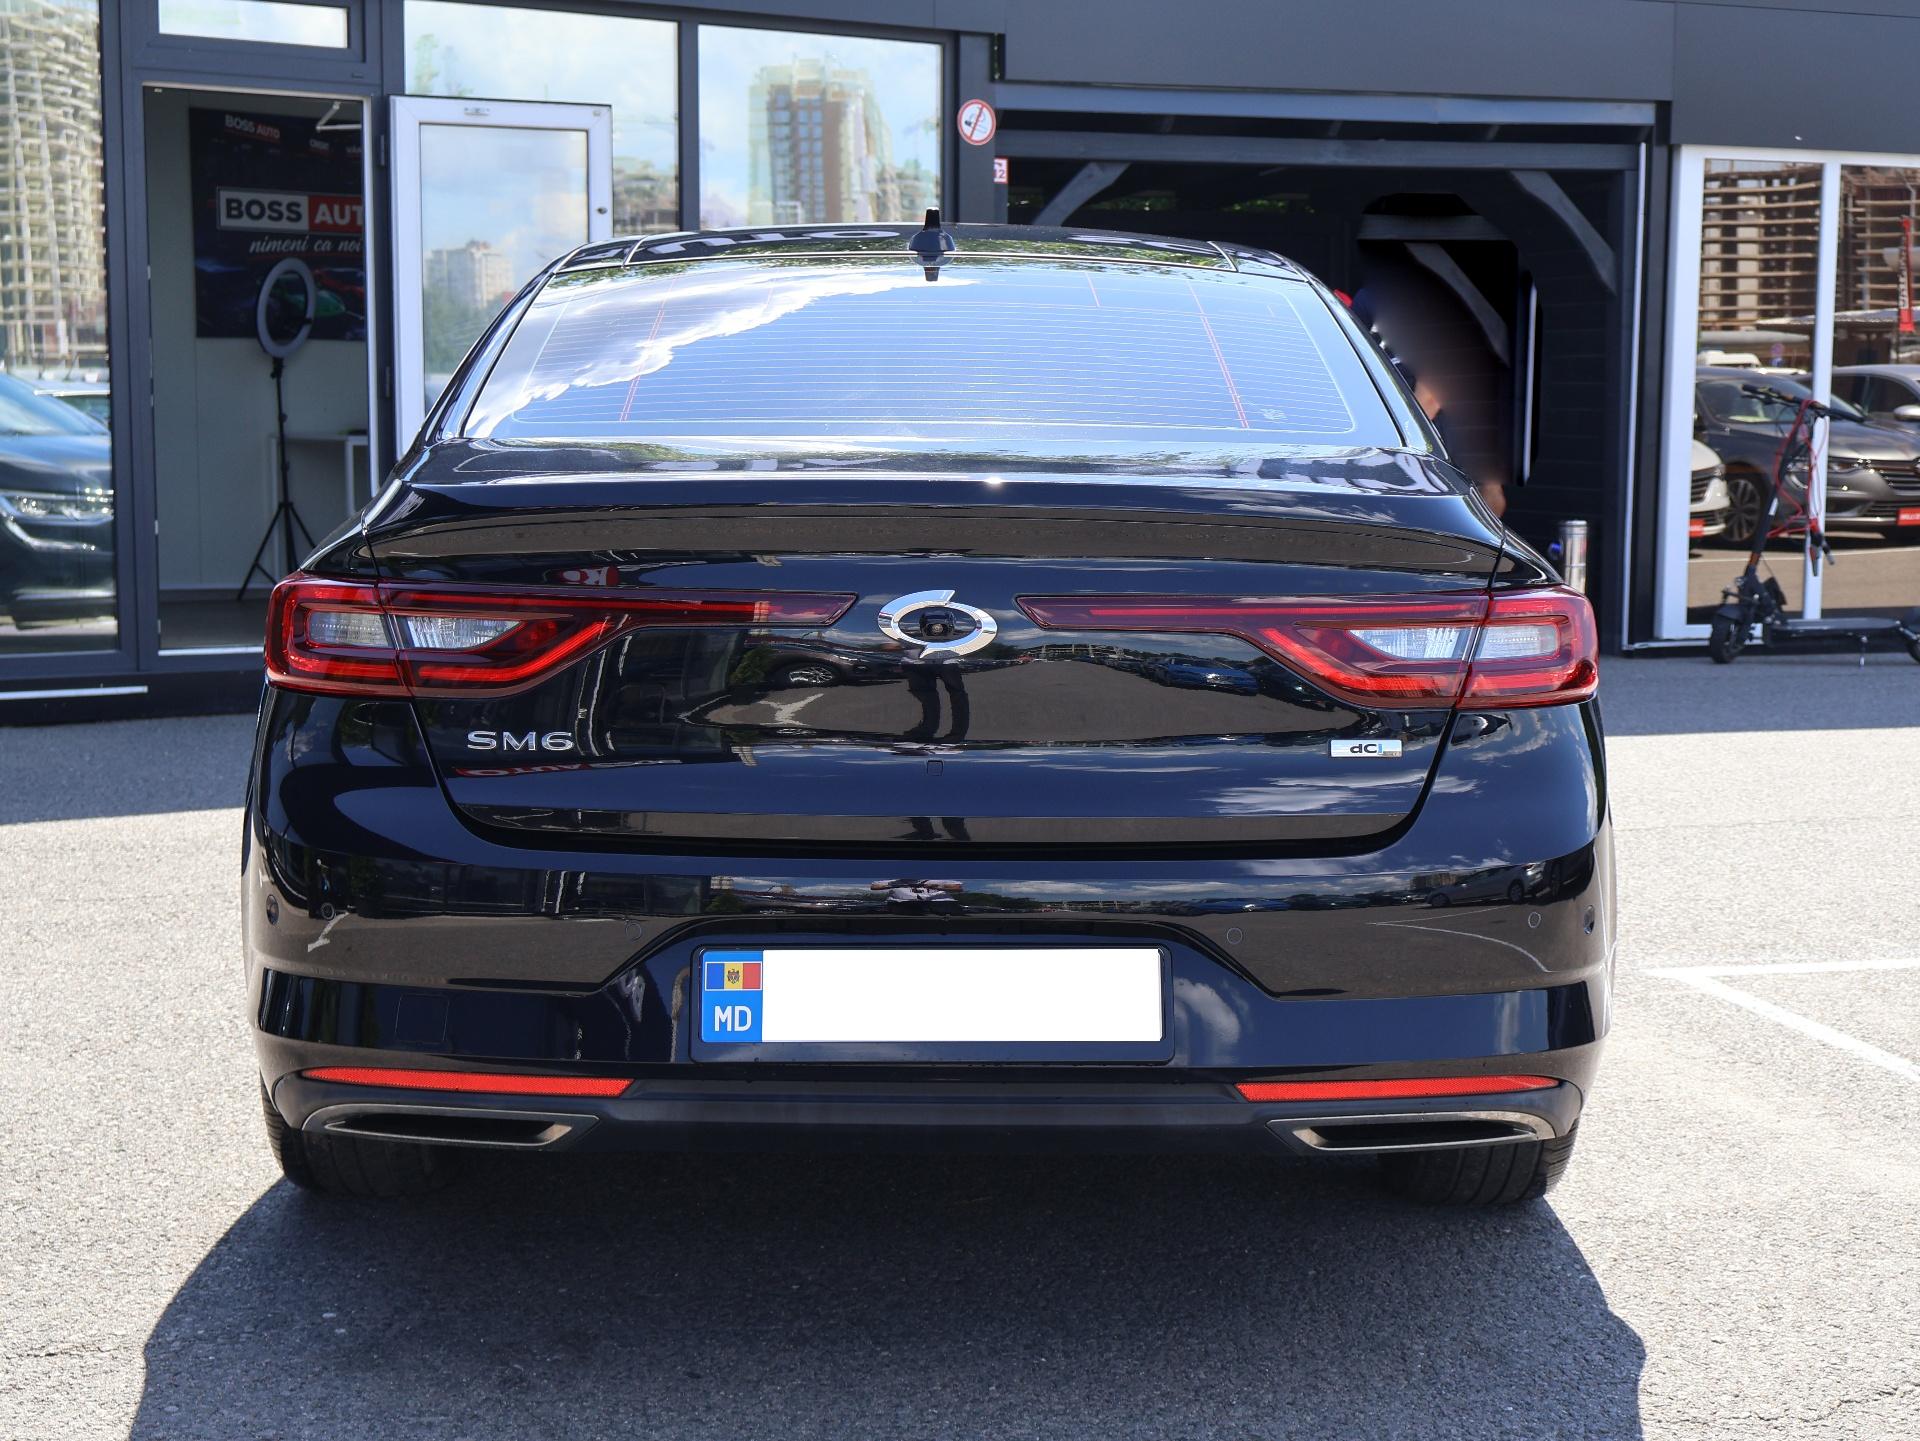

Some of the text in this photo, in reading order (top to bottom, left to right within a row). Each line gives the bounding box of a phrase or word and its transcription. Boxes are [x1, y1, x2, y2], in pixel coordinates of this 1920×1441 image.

[225, 114, 280, 139] BOSS AUTO
[225, 198, 303, 222] BOSS
[250, 235, 309, 254] nimeni
[314, 241, 333, 253] ca
[467, 730, 575, 751] SM6
[714, 1005, 752, 1032] MD
